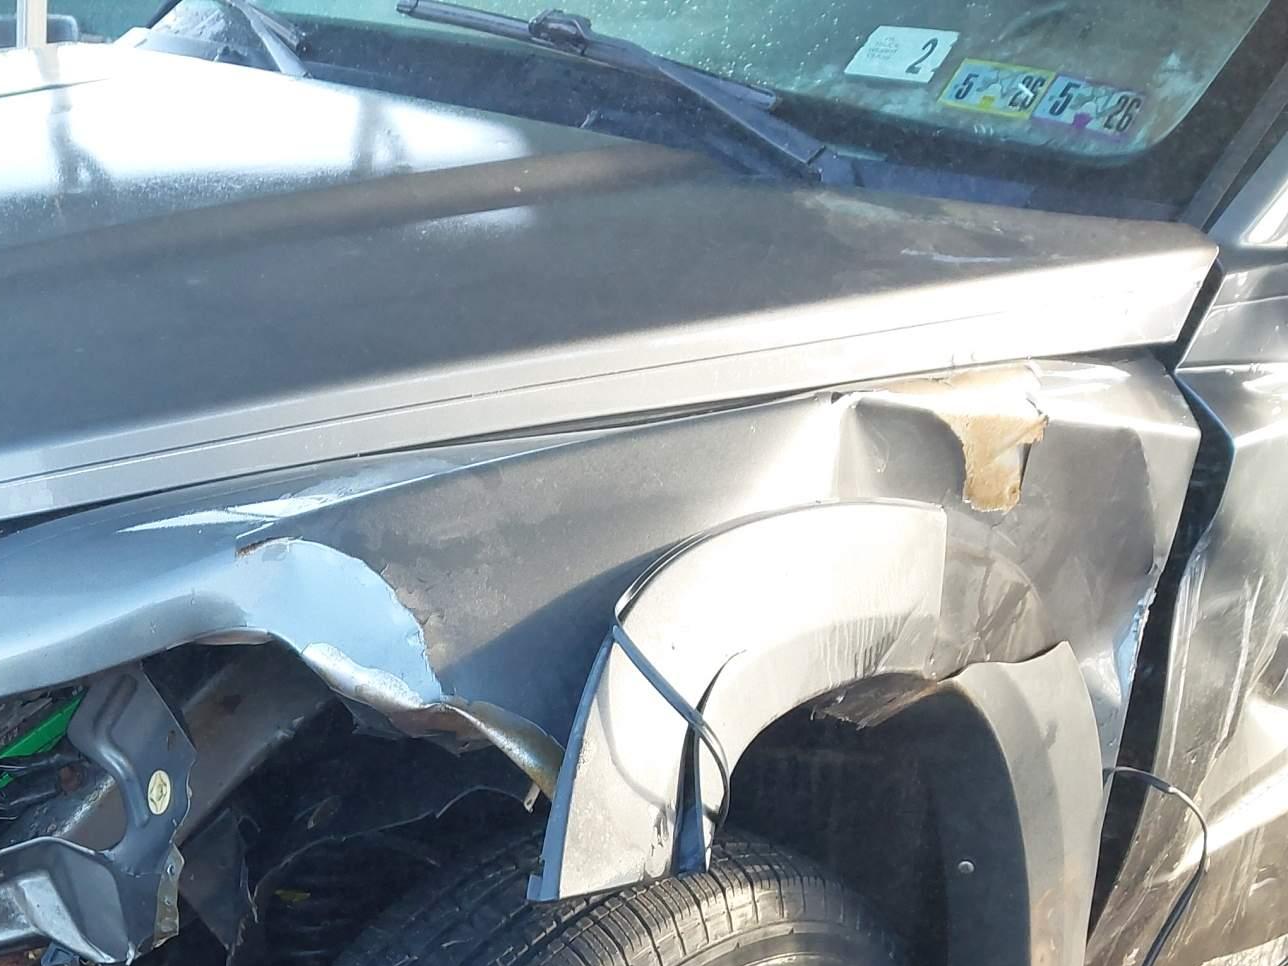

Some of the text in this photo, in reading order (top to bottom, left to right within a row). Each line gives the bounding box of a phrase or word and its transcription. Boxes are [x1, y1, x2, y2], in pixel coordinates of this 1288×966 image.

[905, 37, 939, 74] 2
[955, 73, 979, 100] 5
[1049, 82, 1141, 132] 5 26
